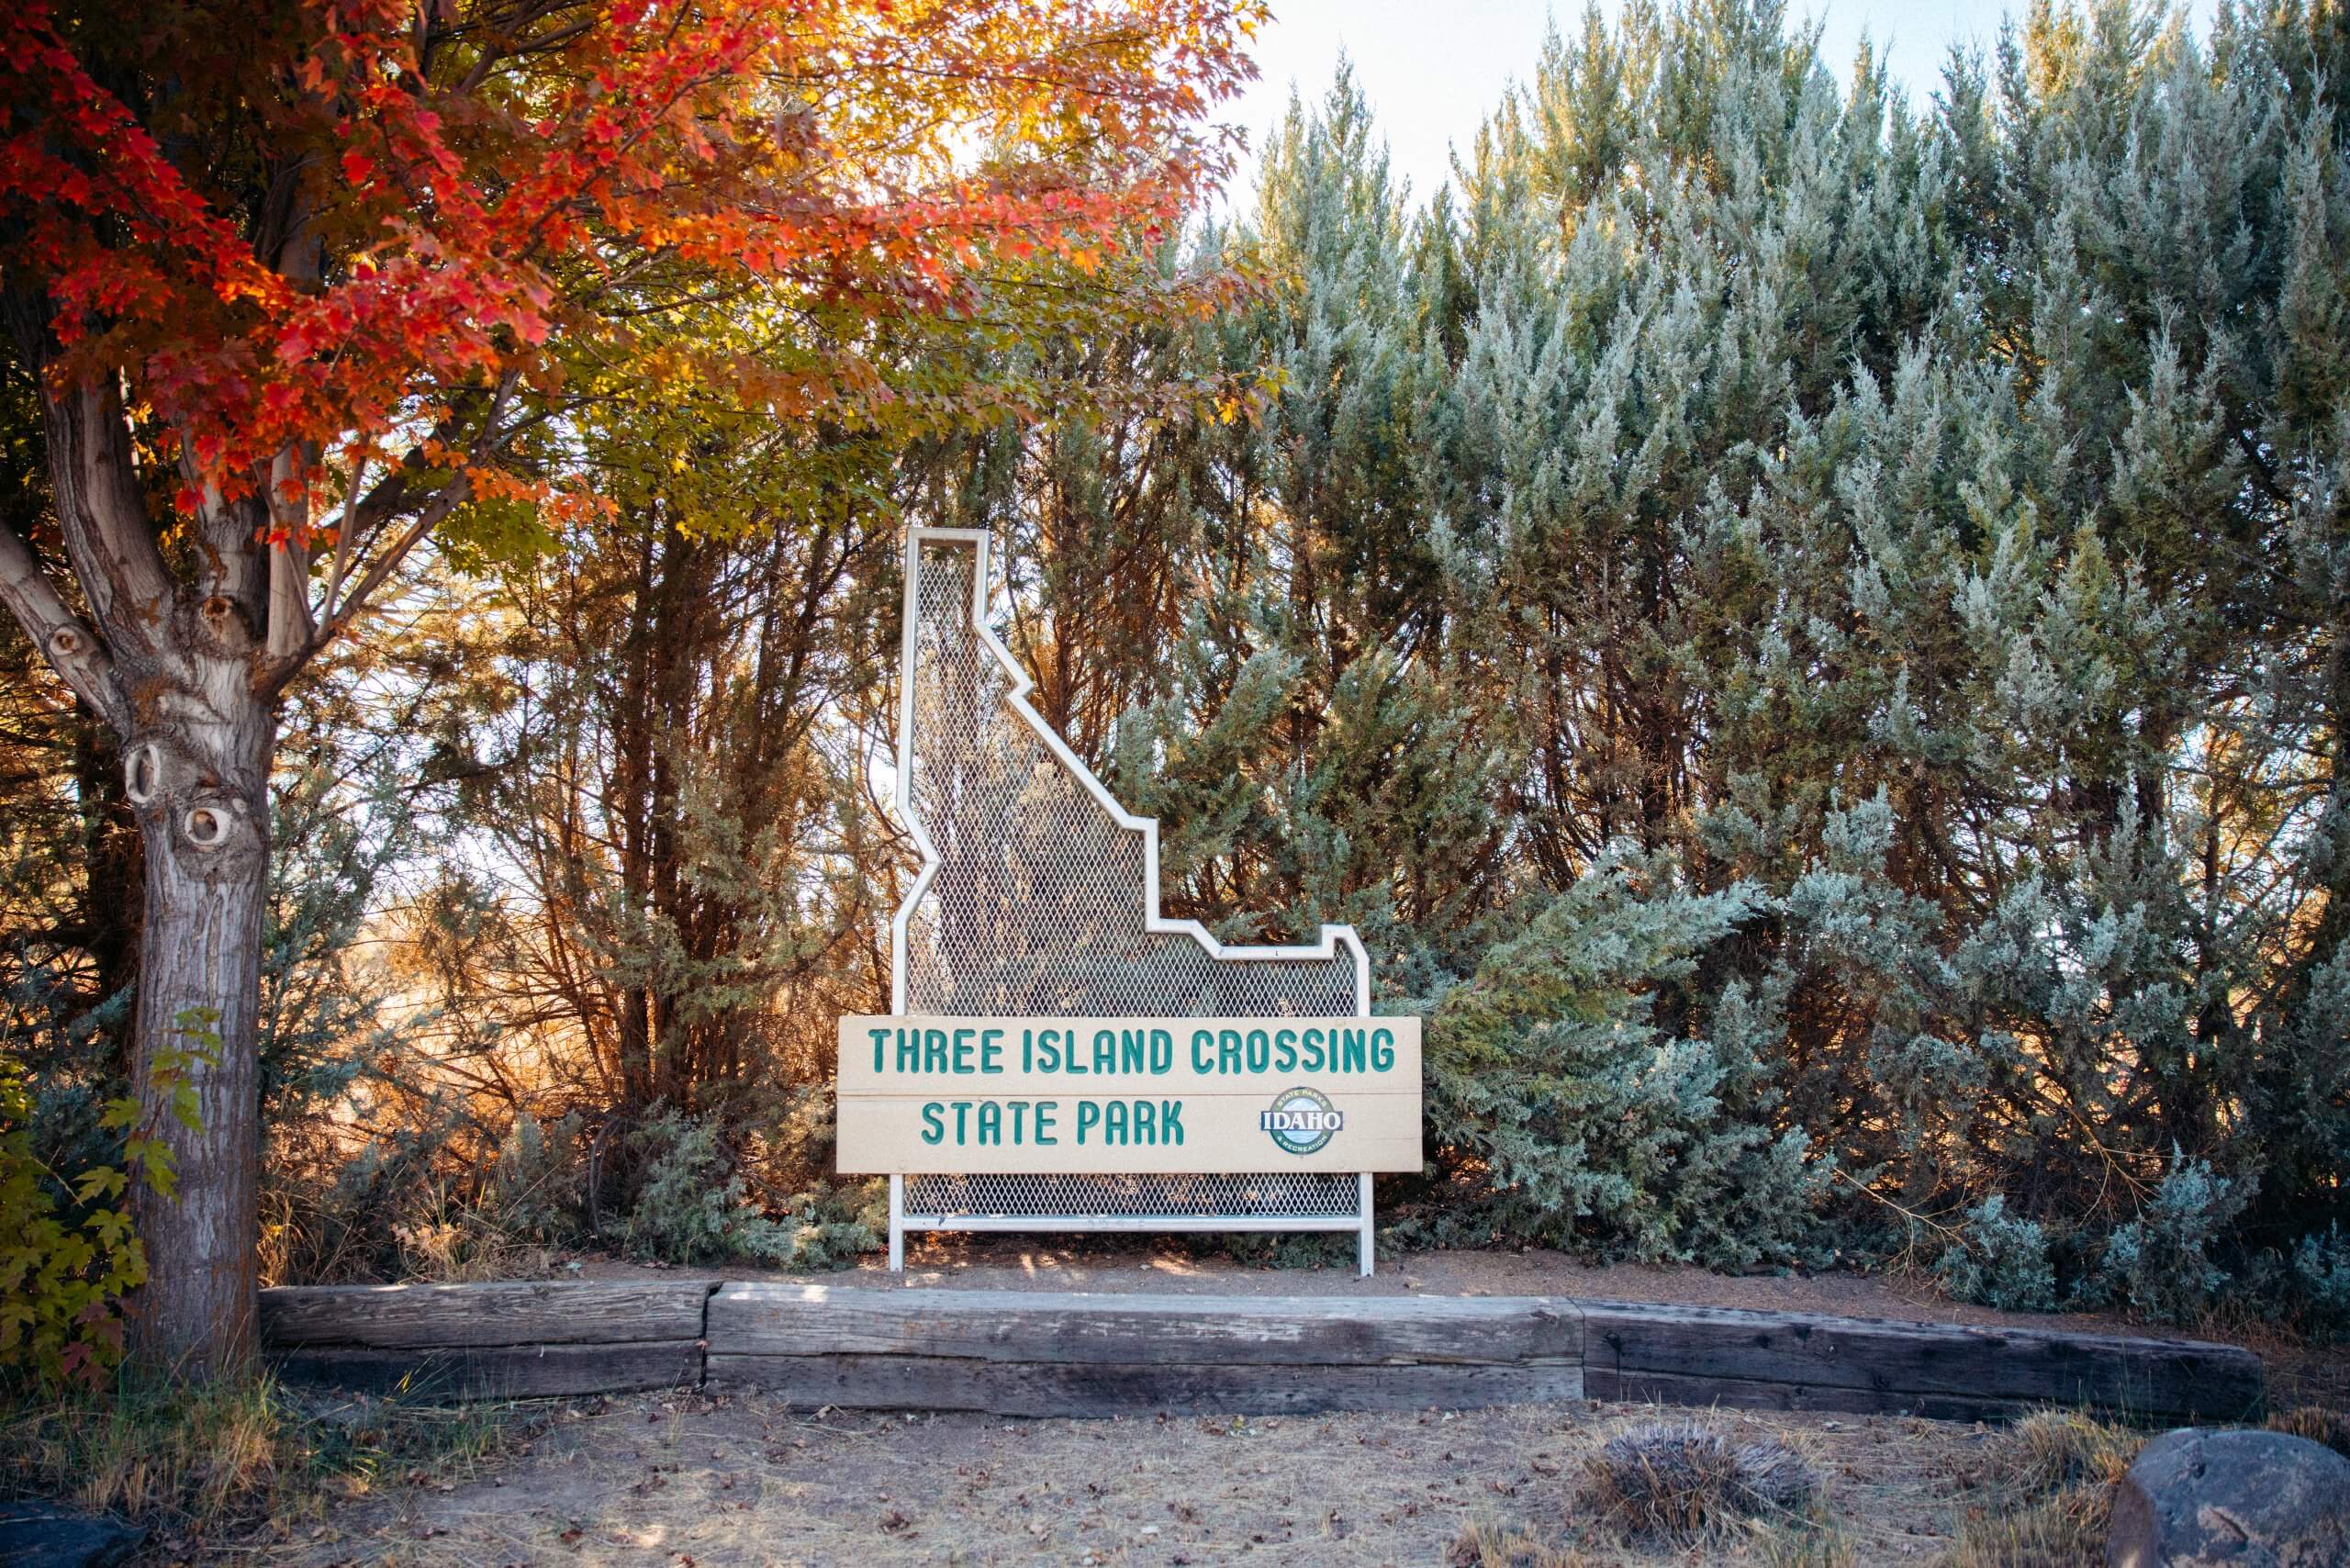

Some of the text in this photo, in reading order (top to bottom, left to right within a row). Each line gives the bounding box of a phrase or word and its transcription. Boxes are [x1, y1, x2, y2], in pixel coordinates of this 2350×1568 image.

[867, 1028, 1396, 1077] THREE ISLAND CROSSING
[1277, 1090, 1327, 1107] STATE PARKS
[921, 1101, 1185, 1147] STATE PARK
[1262, 1112, 1341, 1130] IDAHO
[1282, 1135, 1328, 1152] RECREATION
